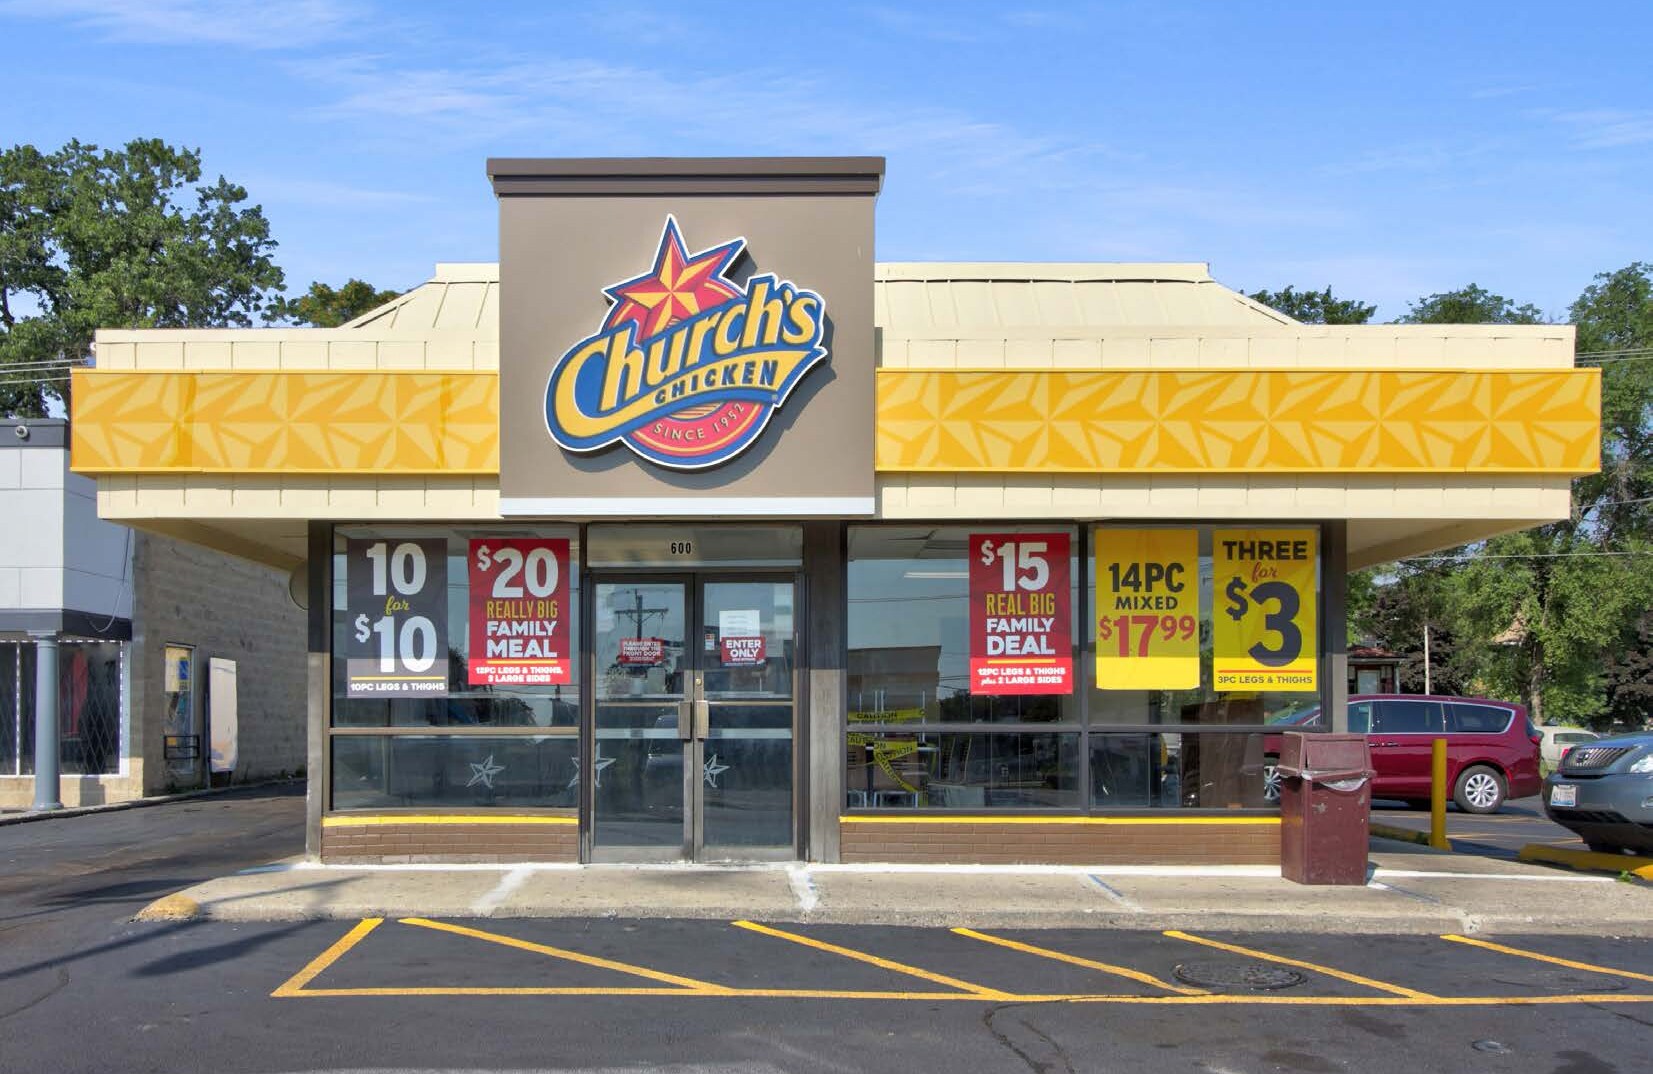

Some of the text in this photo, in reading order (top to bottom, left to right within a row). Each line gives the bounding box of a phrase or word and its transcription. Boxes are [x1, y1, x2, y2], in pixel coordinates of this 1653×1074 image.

[554, 282, 817, 438] Church's
[654, 359, 779, 405] CHICKEN
[653, 402, 745, 440] SINCE 1952
[670, 542, 692, 554] 600
[1222, 540, 1308, 561] THREE
[366, 542, 427, 596] 10
[476, 545, 559, 598] $20
[981, 540, 1049, 592] $15
[1251, 561, 1278, 583] for
[1108, 562, 1185, 593] 14PC
[384, 595, 410, 616] for
[486, 601, 558, 619] REALLY BIG
[986, 594, 1055, 615] REAL BIG
[1115, 595, 1178, 611] MIXED
[486, 620, 558, 637] FAMILY
[986, 617, 1055, 633] FAMILY
[1225, 575, 1303, 668] $3
[354, 613, 438, 673] $10
[486, 639, 558, 658] MEAL
[726, 640, 761, 648] ENTER
[986, 635, 1056, 655] DEAL
[730, 649, 759, 658] ONLY
[495, 674, 525, 682] LARGE
[526, 674, 551, 682] SIDES
[497, 666, 520, 674] LEGS
[522, 666, 528, 674] &
[1000, 667, 1024, 675] LEGS
[1026, 667, 1032, 675] &
[1033, 667, 1066, 675] THIGHS
[1217, 675, 1313, 684] 3PC LEGS & THIGHS
[350, 682, 446, 691] 10PC LEGS & THIGHS
[1006, 676, 1035, 684] LARGE
[1037, 676, 1062, 684] SIDES
